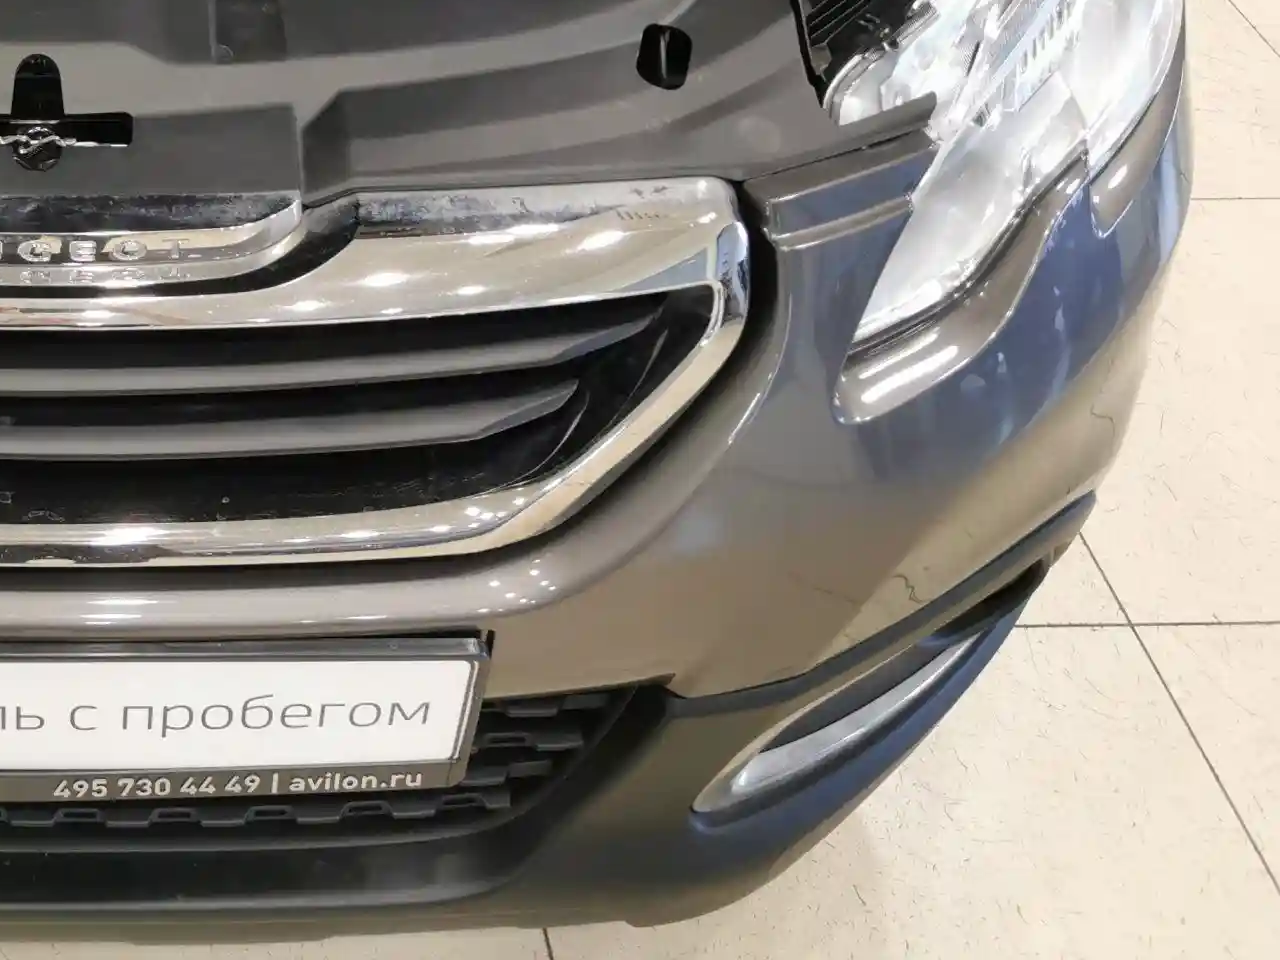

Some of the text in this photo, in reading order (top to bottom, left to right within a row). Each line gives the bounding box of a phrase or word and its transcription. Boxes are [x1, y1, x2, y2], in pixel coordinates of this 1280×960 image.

[69, 704, 99, 731] с
[121, 693, 431, 738] пробегом
[53, 778, 108, 798] 495
[117, 777, 171, 797] 730
[179, 776, 217, 795] 44
[224, 774, 261, 794] 49
[288, 771, 423, 792] avilon.ru
